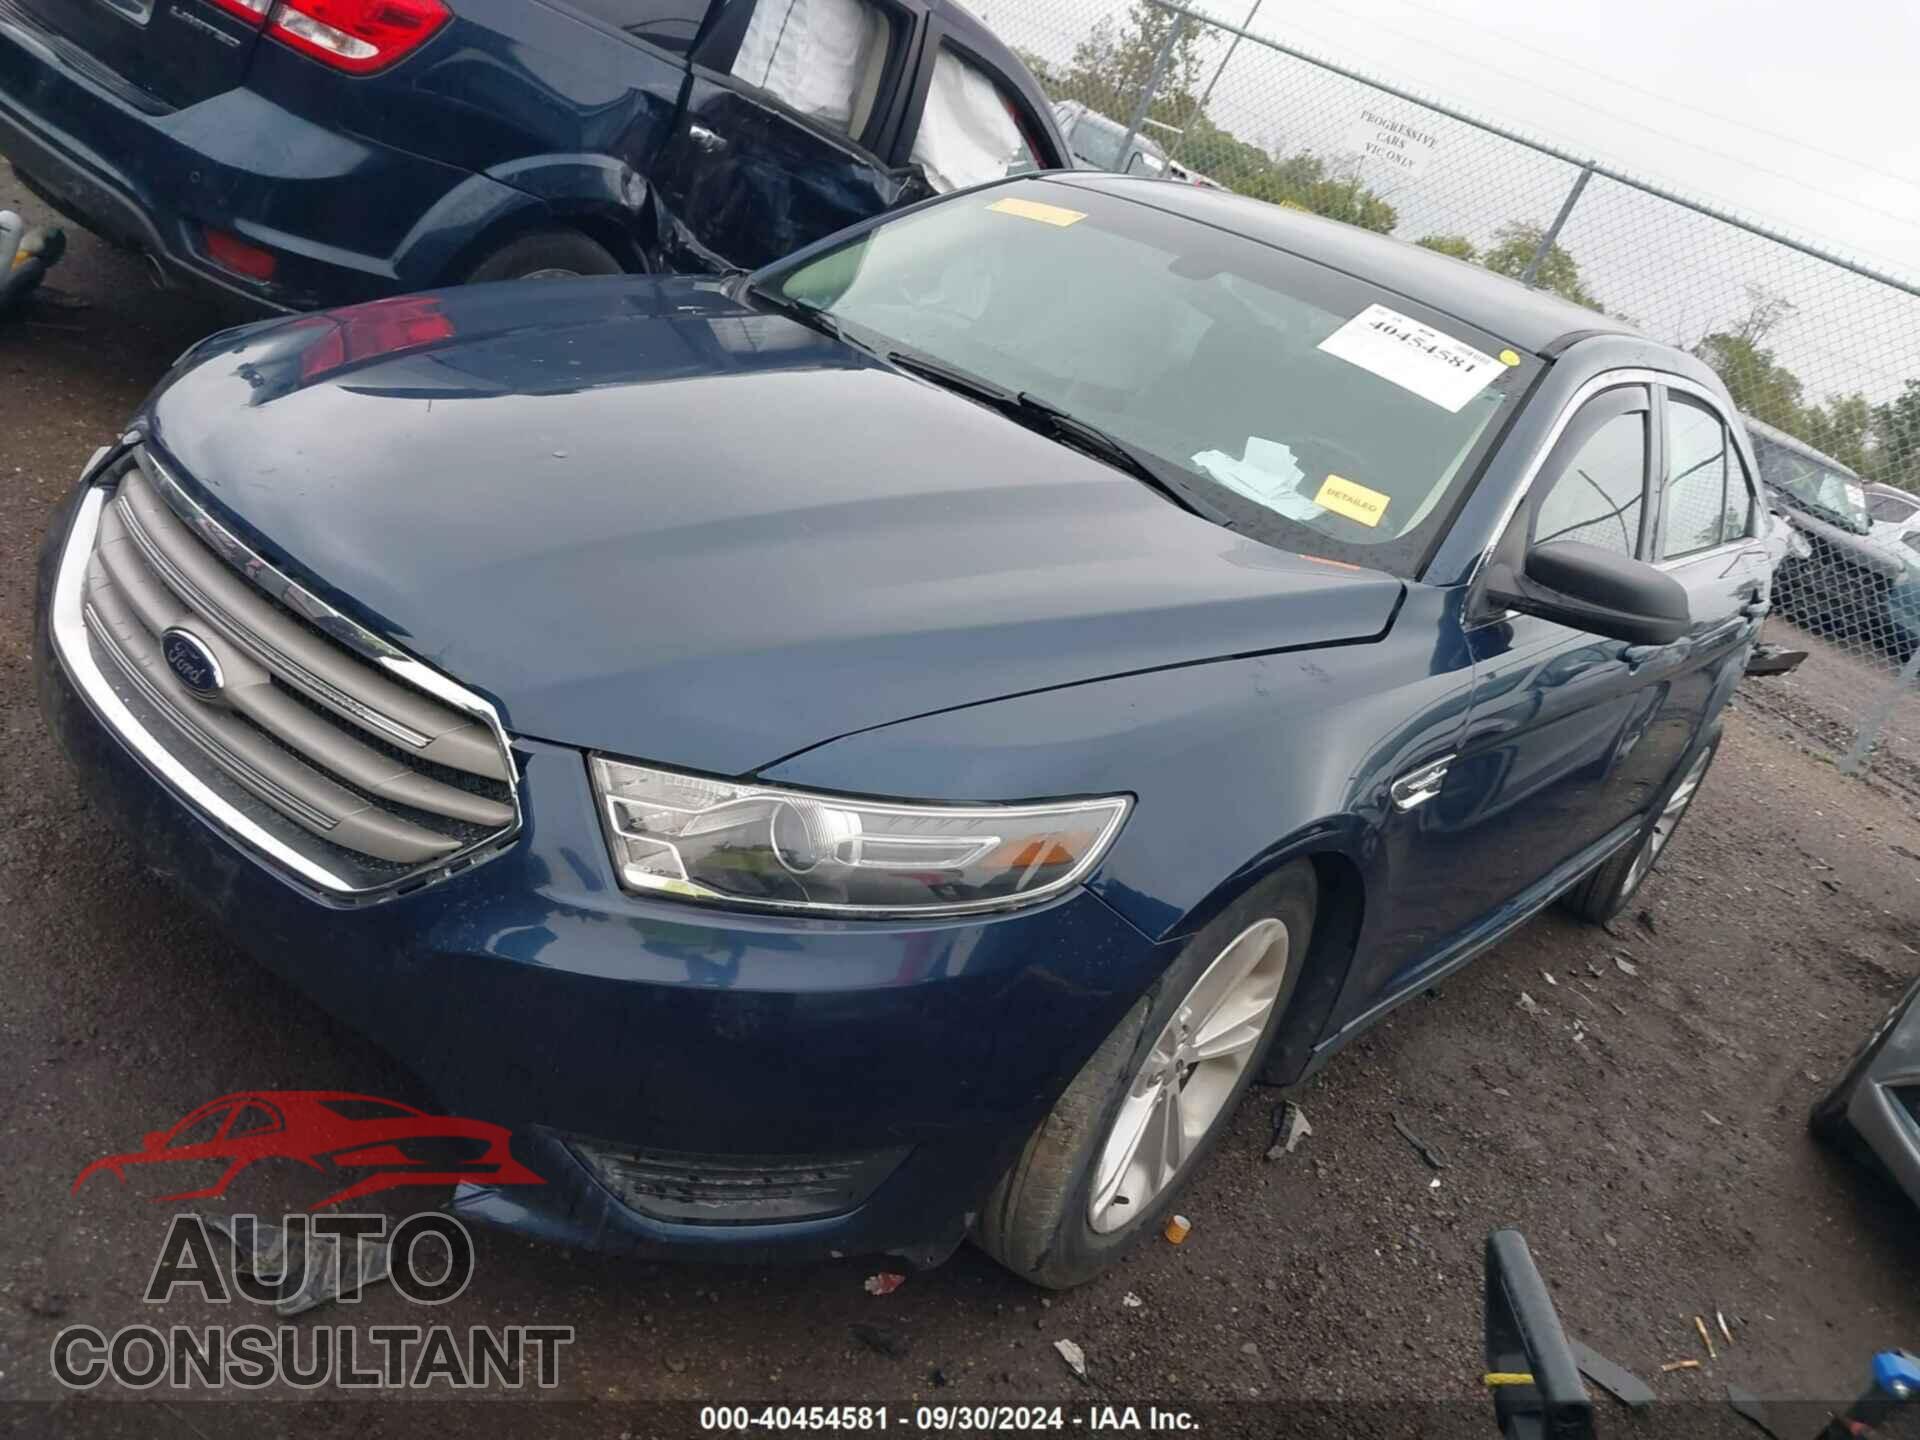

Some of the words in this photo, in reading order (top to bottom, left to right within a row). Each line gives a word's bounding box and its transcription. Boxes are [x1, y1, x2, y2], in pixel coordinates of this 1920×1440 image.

[1360, 110, 1438, 150] PROGRESSIVE
[1376, 132, 1405, 149] CARS
[1386, 150, 1416, 169] ONLY
[1368, 320, 1477, 374] 40454581
[1326, 487, 1379, 513] DETAILED
[167, 640, 207, 685] Ford
